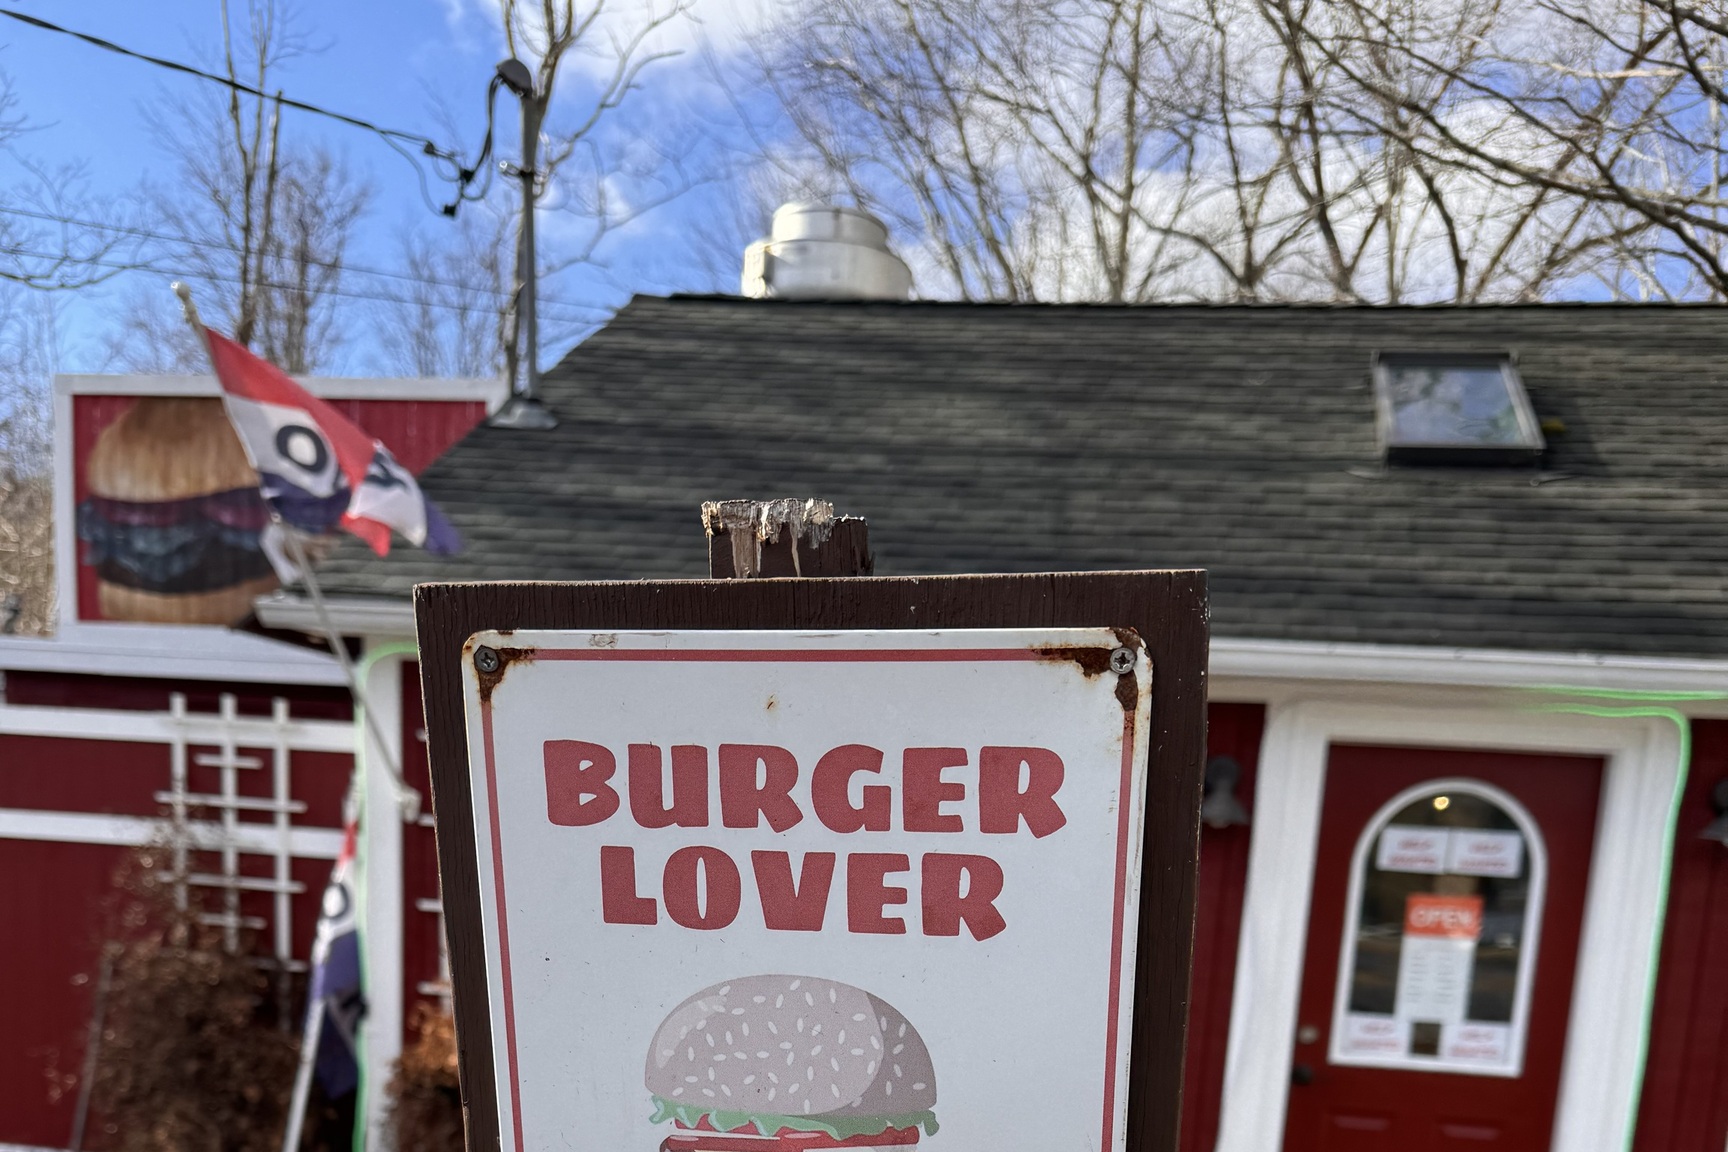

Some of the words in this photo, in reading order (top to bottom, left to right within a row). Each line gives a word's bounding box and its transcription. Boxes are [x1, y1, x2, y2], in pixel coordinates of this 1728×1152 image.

[543, 740, 1067, 839] BURGER
[601, 846, 1006, 941] LOVER
[1408, 904, 1475, 930] OPEN
